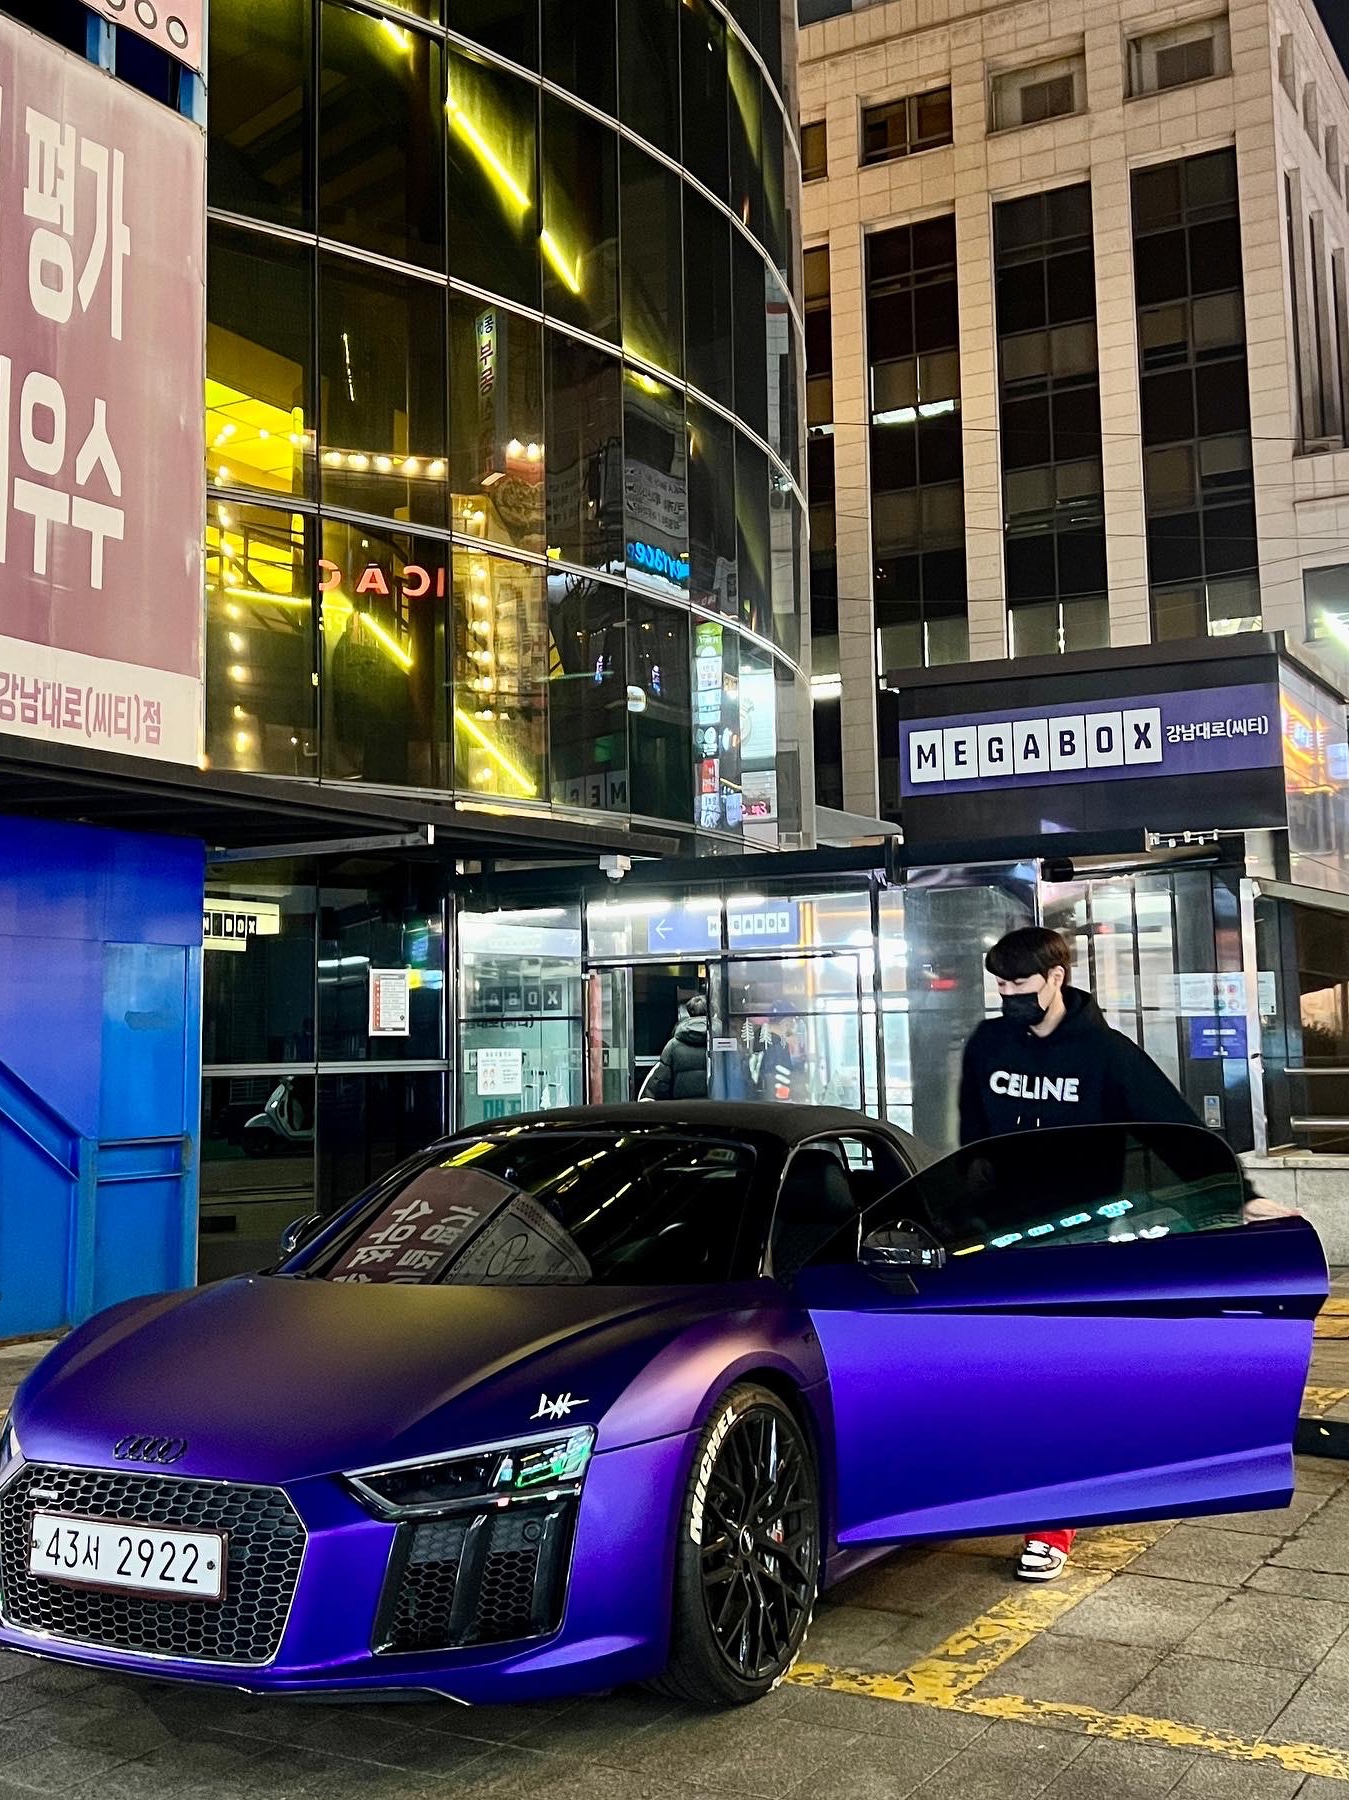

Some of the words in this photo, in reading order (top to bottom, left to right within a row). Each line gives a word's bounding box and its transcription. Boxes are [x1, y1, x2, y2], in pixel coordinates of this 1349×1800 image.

[23, 106, 131, 341] 평가
[0, 355, 125, 590] 우수
[0, 672, 162, 745] 강남대로(씨티)점
[916, 721, 1152, 770] MEGABOX
[1166, 715, 1268, 743] 강남대로(씨티)
[710, 916, 787, 931] MGABOX
[989, 1071, 1080, 1102] CELINE
[45, 1527, 100, 1570] 43서
[117, 1536, 200, 1584] 2922
